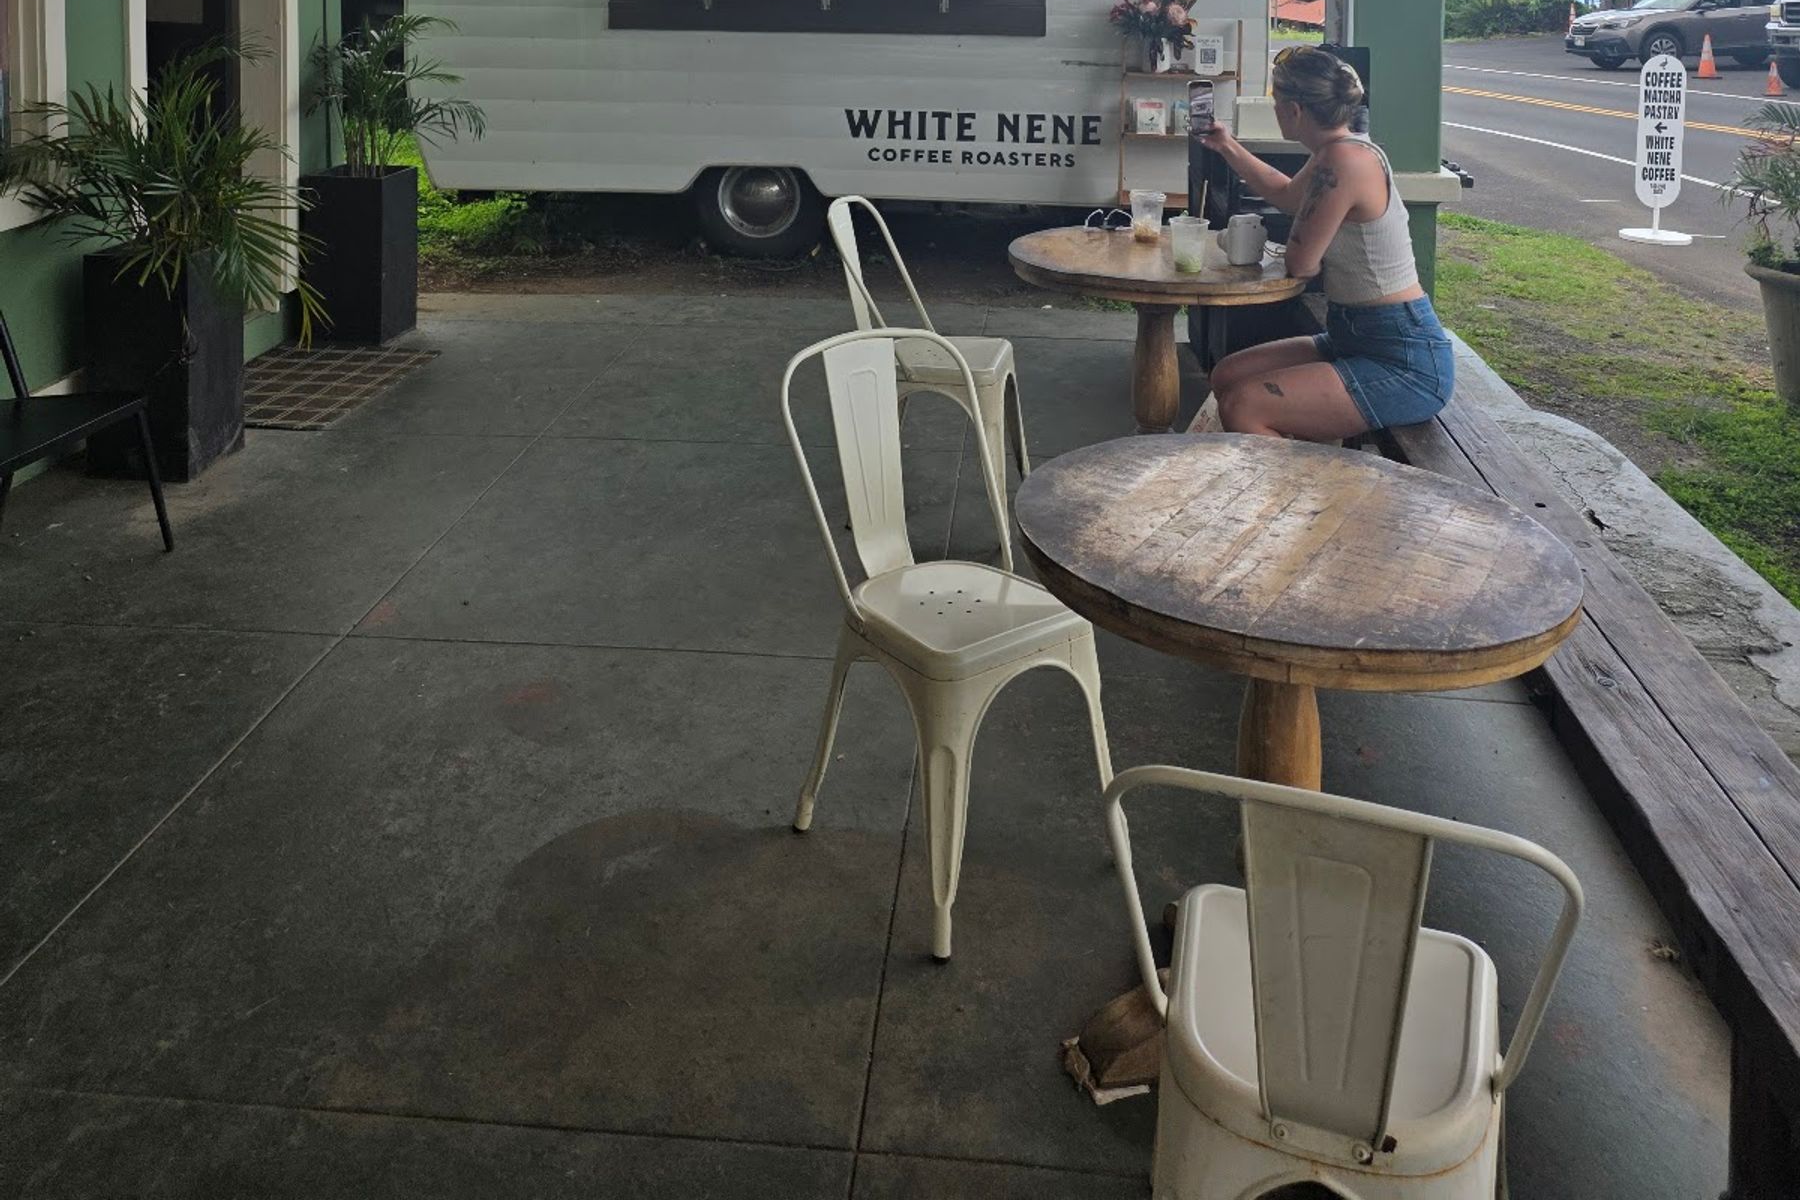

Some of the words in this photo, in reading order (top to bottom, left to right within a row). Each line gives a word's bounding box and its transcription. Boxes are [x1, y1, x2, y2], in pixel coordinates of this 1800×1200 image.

[1645, 71, 1682, 88] COFFEE
[1644, 89, 1681, 104] MATCHA
[1644, 105, 1680, 120] PASTRY
[844, 108, 976, 142] WHITE
[996, 113, 1102, 145] NENE
[1645, 135, 1675, 150] WHITE
[868, 147, 952, 164] COFFEE
[961, 150, 1076, 168] ROASTERS
[1647, 151, 1671, 166] NENE
[1642, 167, 1676, 181] COFFEE
